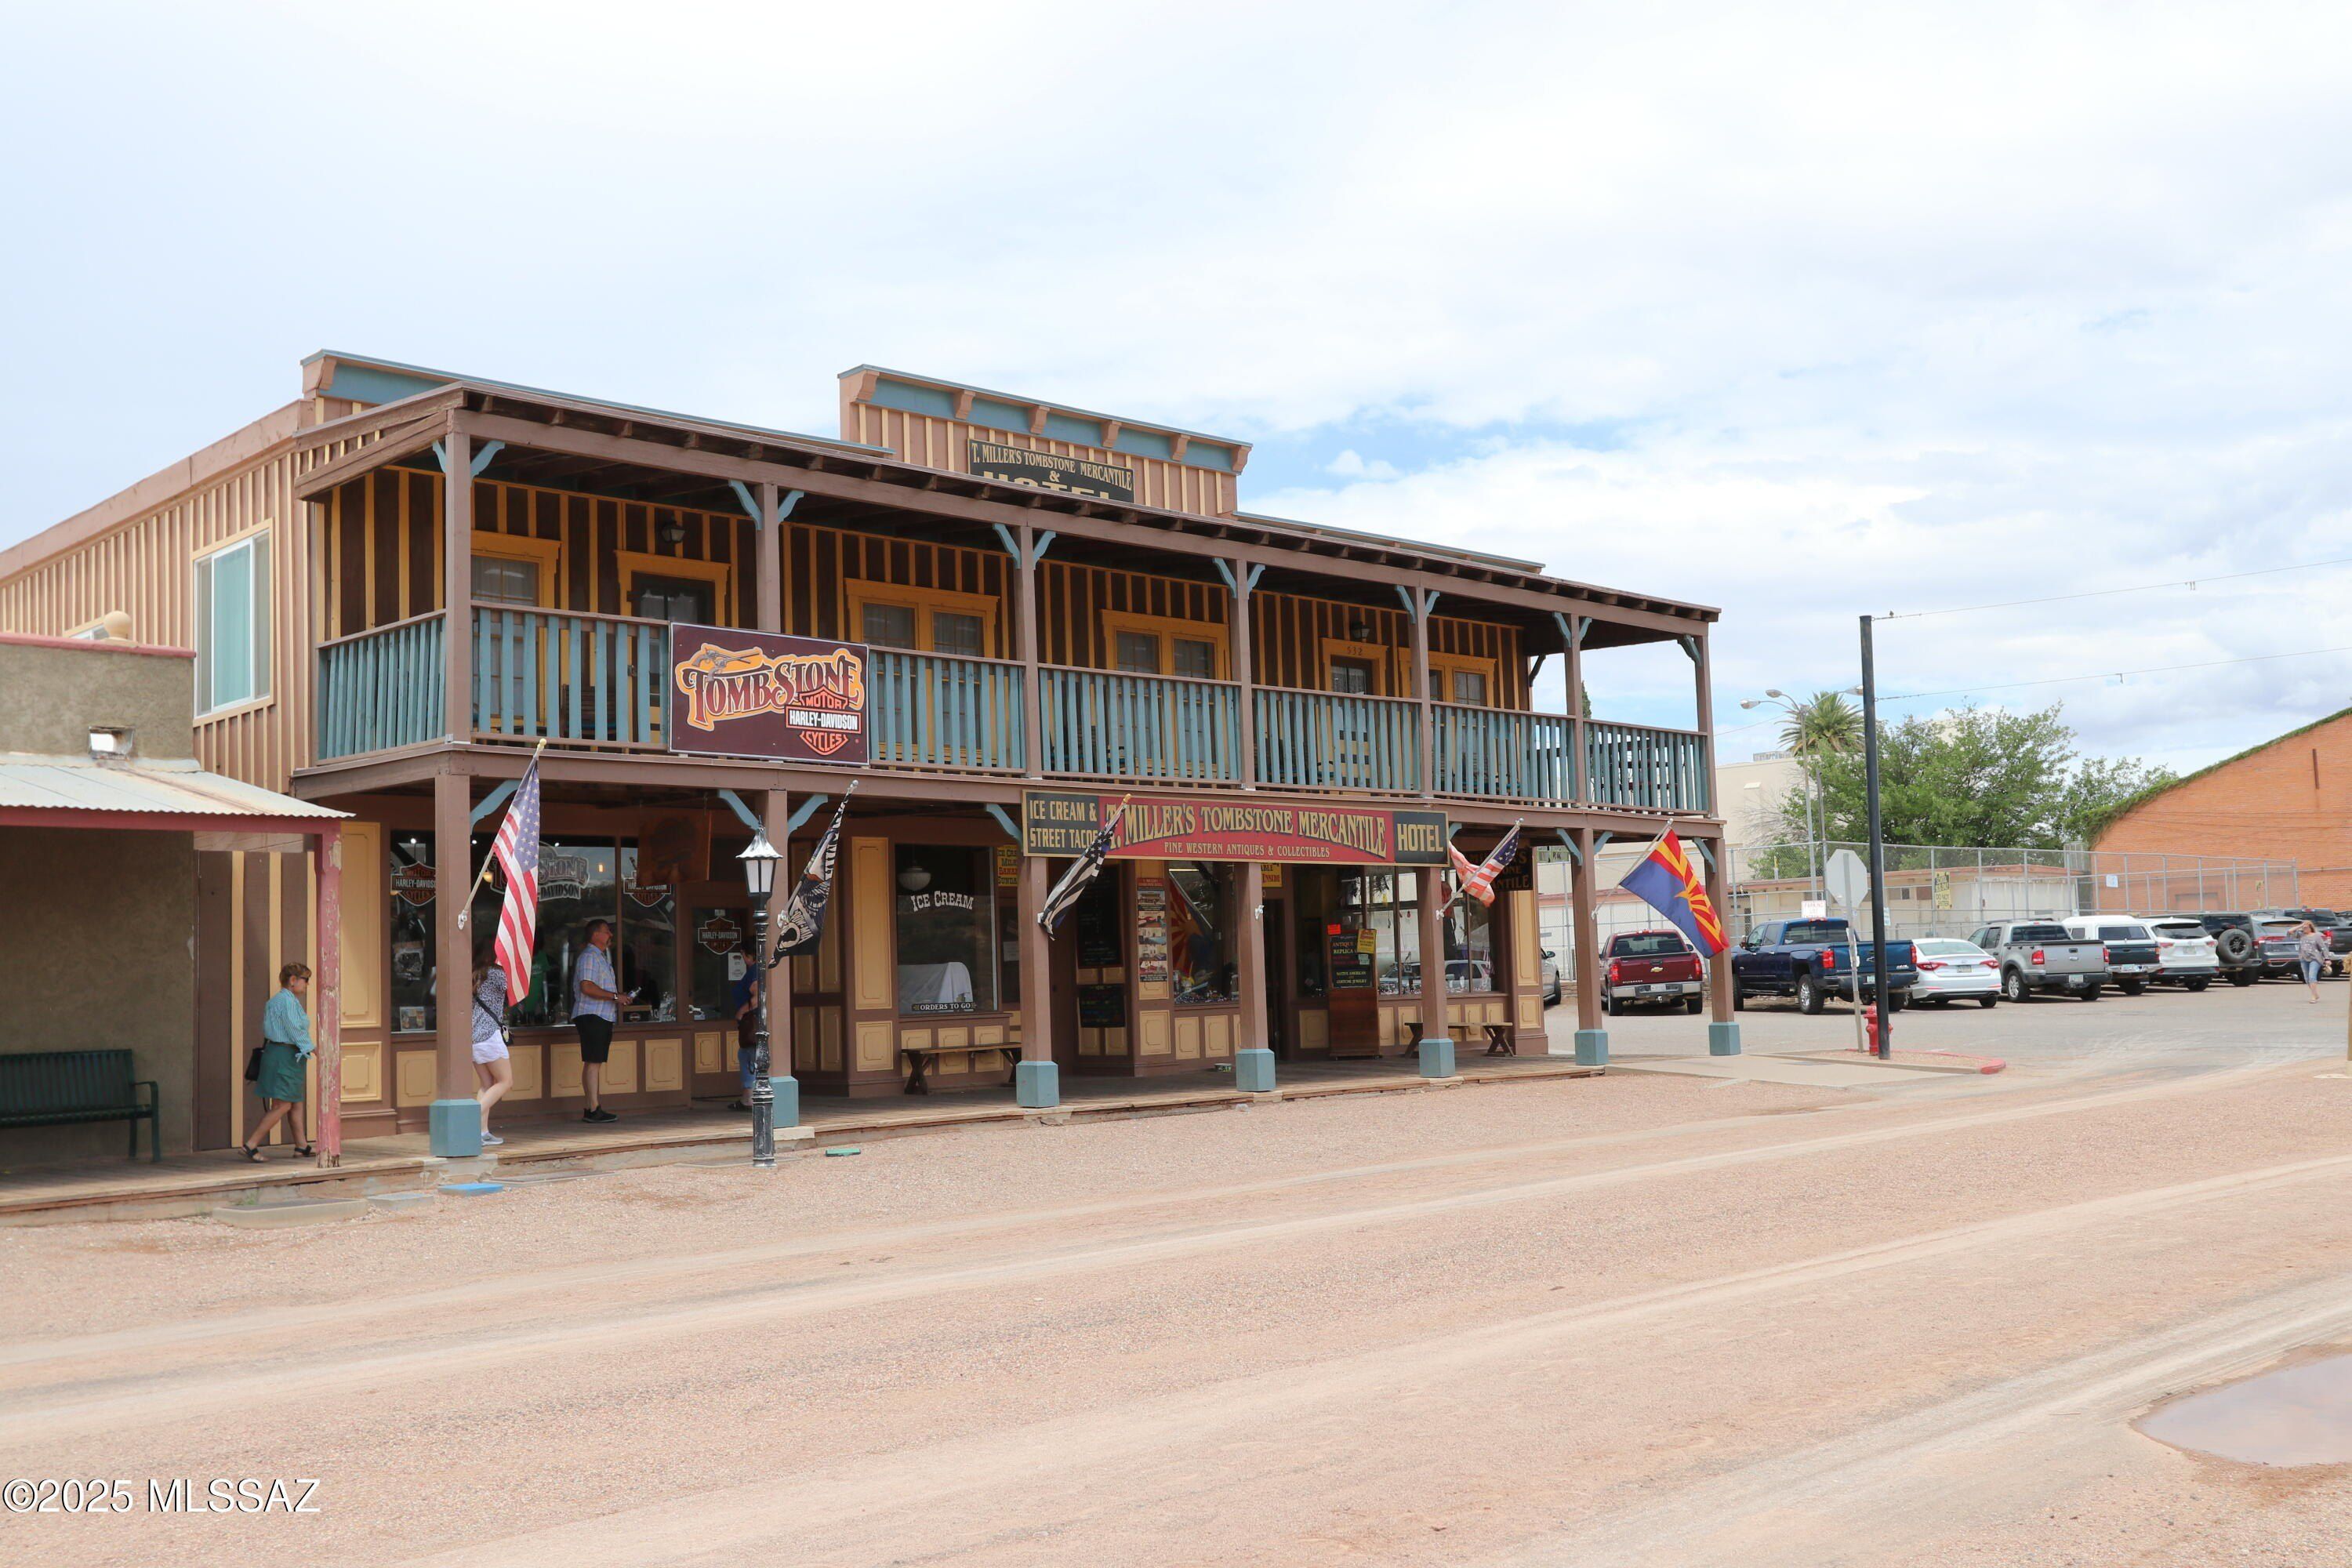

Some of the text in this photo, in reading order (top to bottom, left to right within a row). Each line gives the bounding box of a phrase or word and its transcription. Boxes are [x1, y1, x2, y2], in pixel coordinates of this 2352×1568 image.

[971, 443, 980, 463] T.
[982, 444, 1022, 465] MILLER'S
[1023, 452, 1076, 474] TOMBSTONE
[1080, 462, 1132, 492] MERCANTILE
[1049, 470, 1061, 482] &
[682, 654, 861, 725] TOMBSTONE
[805, 694, 843, 709] MOTOR
[789, 710, 858, 730] HARLEY-DAVIDSON
[805, 732, 844, 753] CYCLES
[1029, 800, 1098, 822] ICE CREAM &
[1029, 827, 1066, 848] STREET
[1124, 803, 1196, 843] MILLER'S
[1200, 806, 1294, 835] TOMBSTONE
[1298, 811, 1387, 858] MERCANTILE
[1396, 823, 1444, 852] HOTEL
[1164, 842, 1330, 858] FINE WESTERN ANTIQUES & COLLECTIBLES
[910, 890, 975, 912] ICE CREAM
